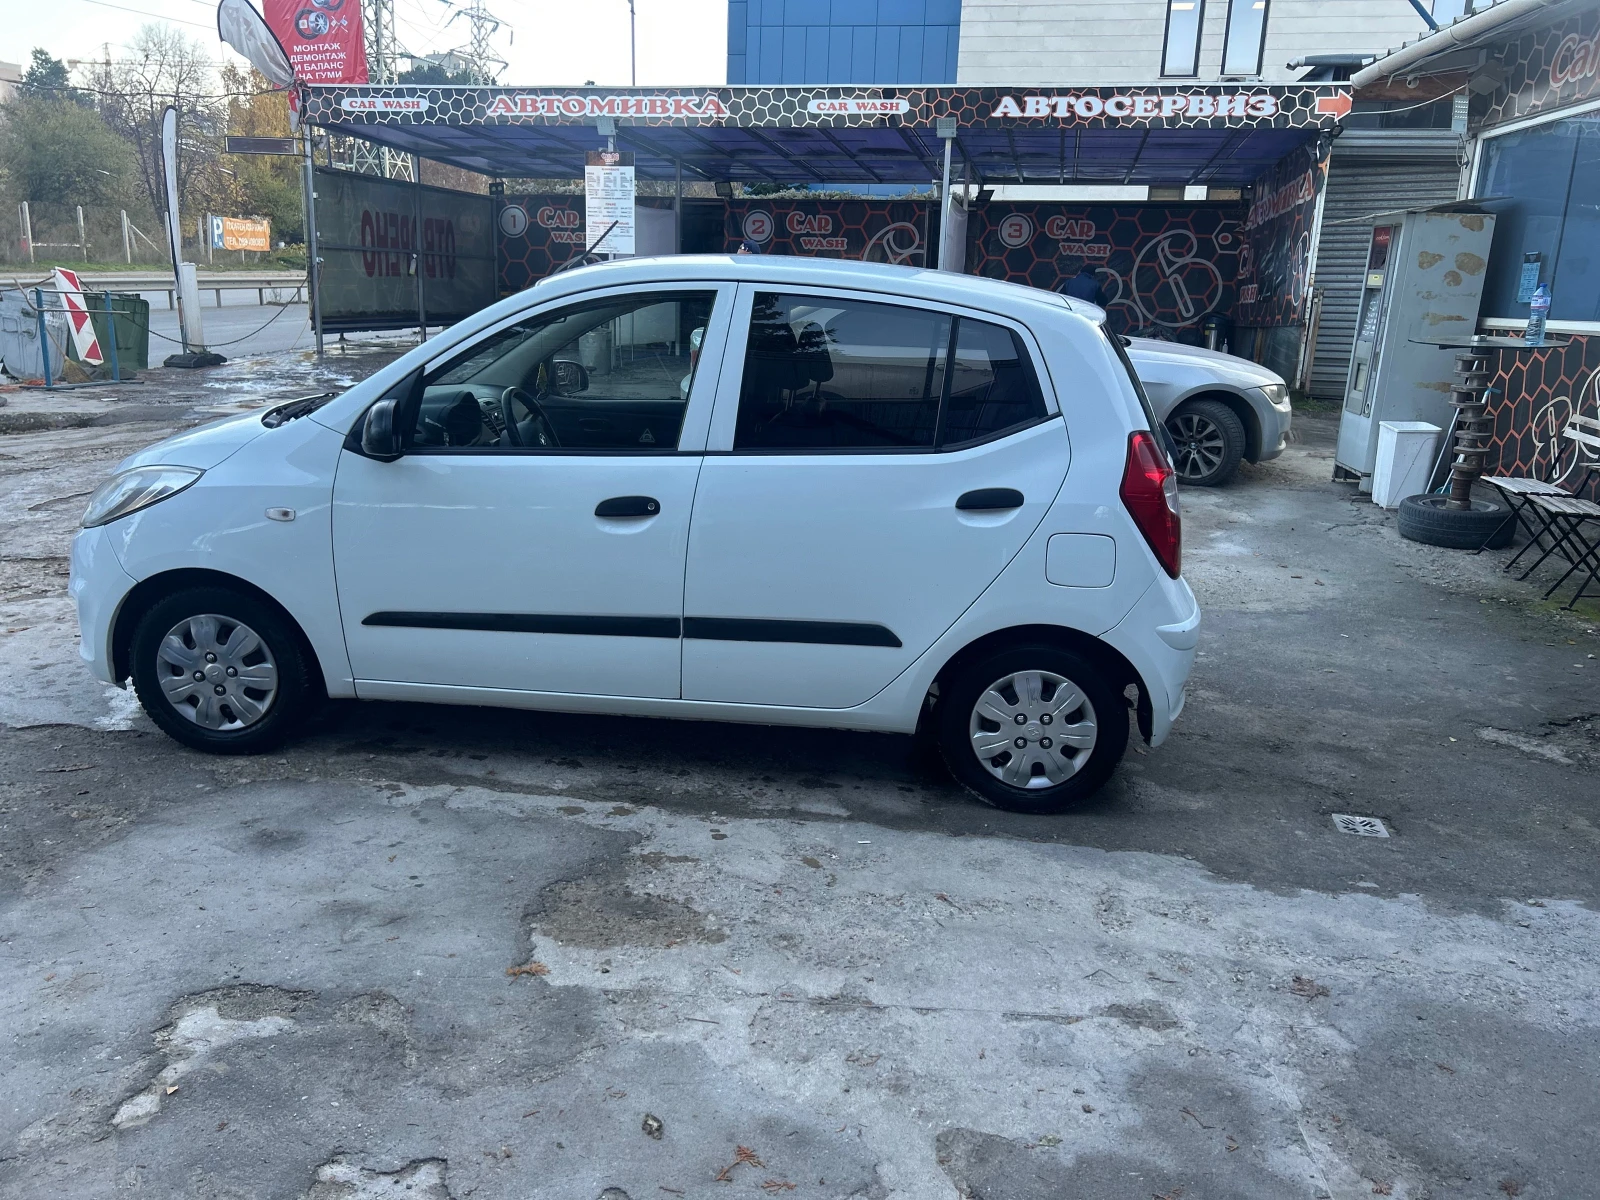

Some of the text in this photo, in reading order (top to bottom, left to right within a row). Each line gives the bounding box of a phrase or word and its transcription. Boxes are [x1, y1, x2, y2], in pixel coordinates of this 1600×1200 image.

[293, 43, 340, 52] МОНТАЖ
[290, 52, 346, 63] ДЕМОНТАЖ
[295, 62, 343, 72] И БАЛАНС
[316, 71, 342, 79] ГУМИ
[349, 100, 421, 109] CAR WASH
[488, 95, 729, 117] АВТОМИВКА
[816, 102, 900, 111] CAR WASH
[991, 95, 1279, 118] АВТОСЕРВИЗ
[511, 215, 516, 228] 1
[538, 207, 579, 228] CAR
[752, 210, 832, 234] 2 CAR
[1008, 214, 1096, 240] 3 CAR
[800, 236, 848, 250] WASH
[1059, 242, 1111, 257] WASH
